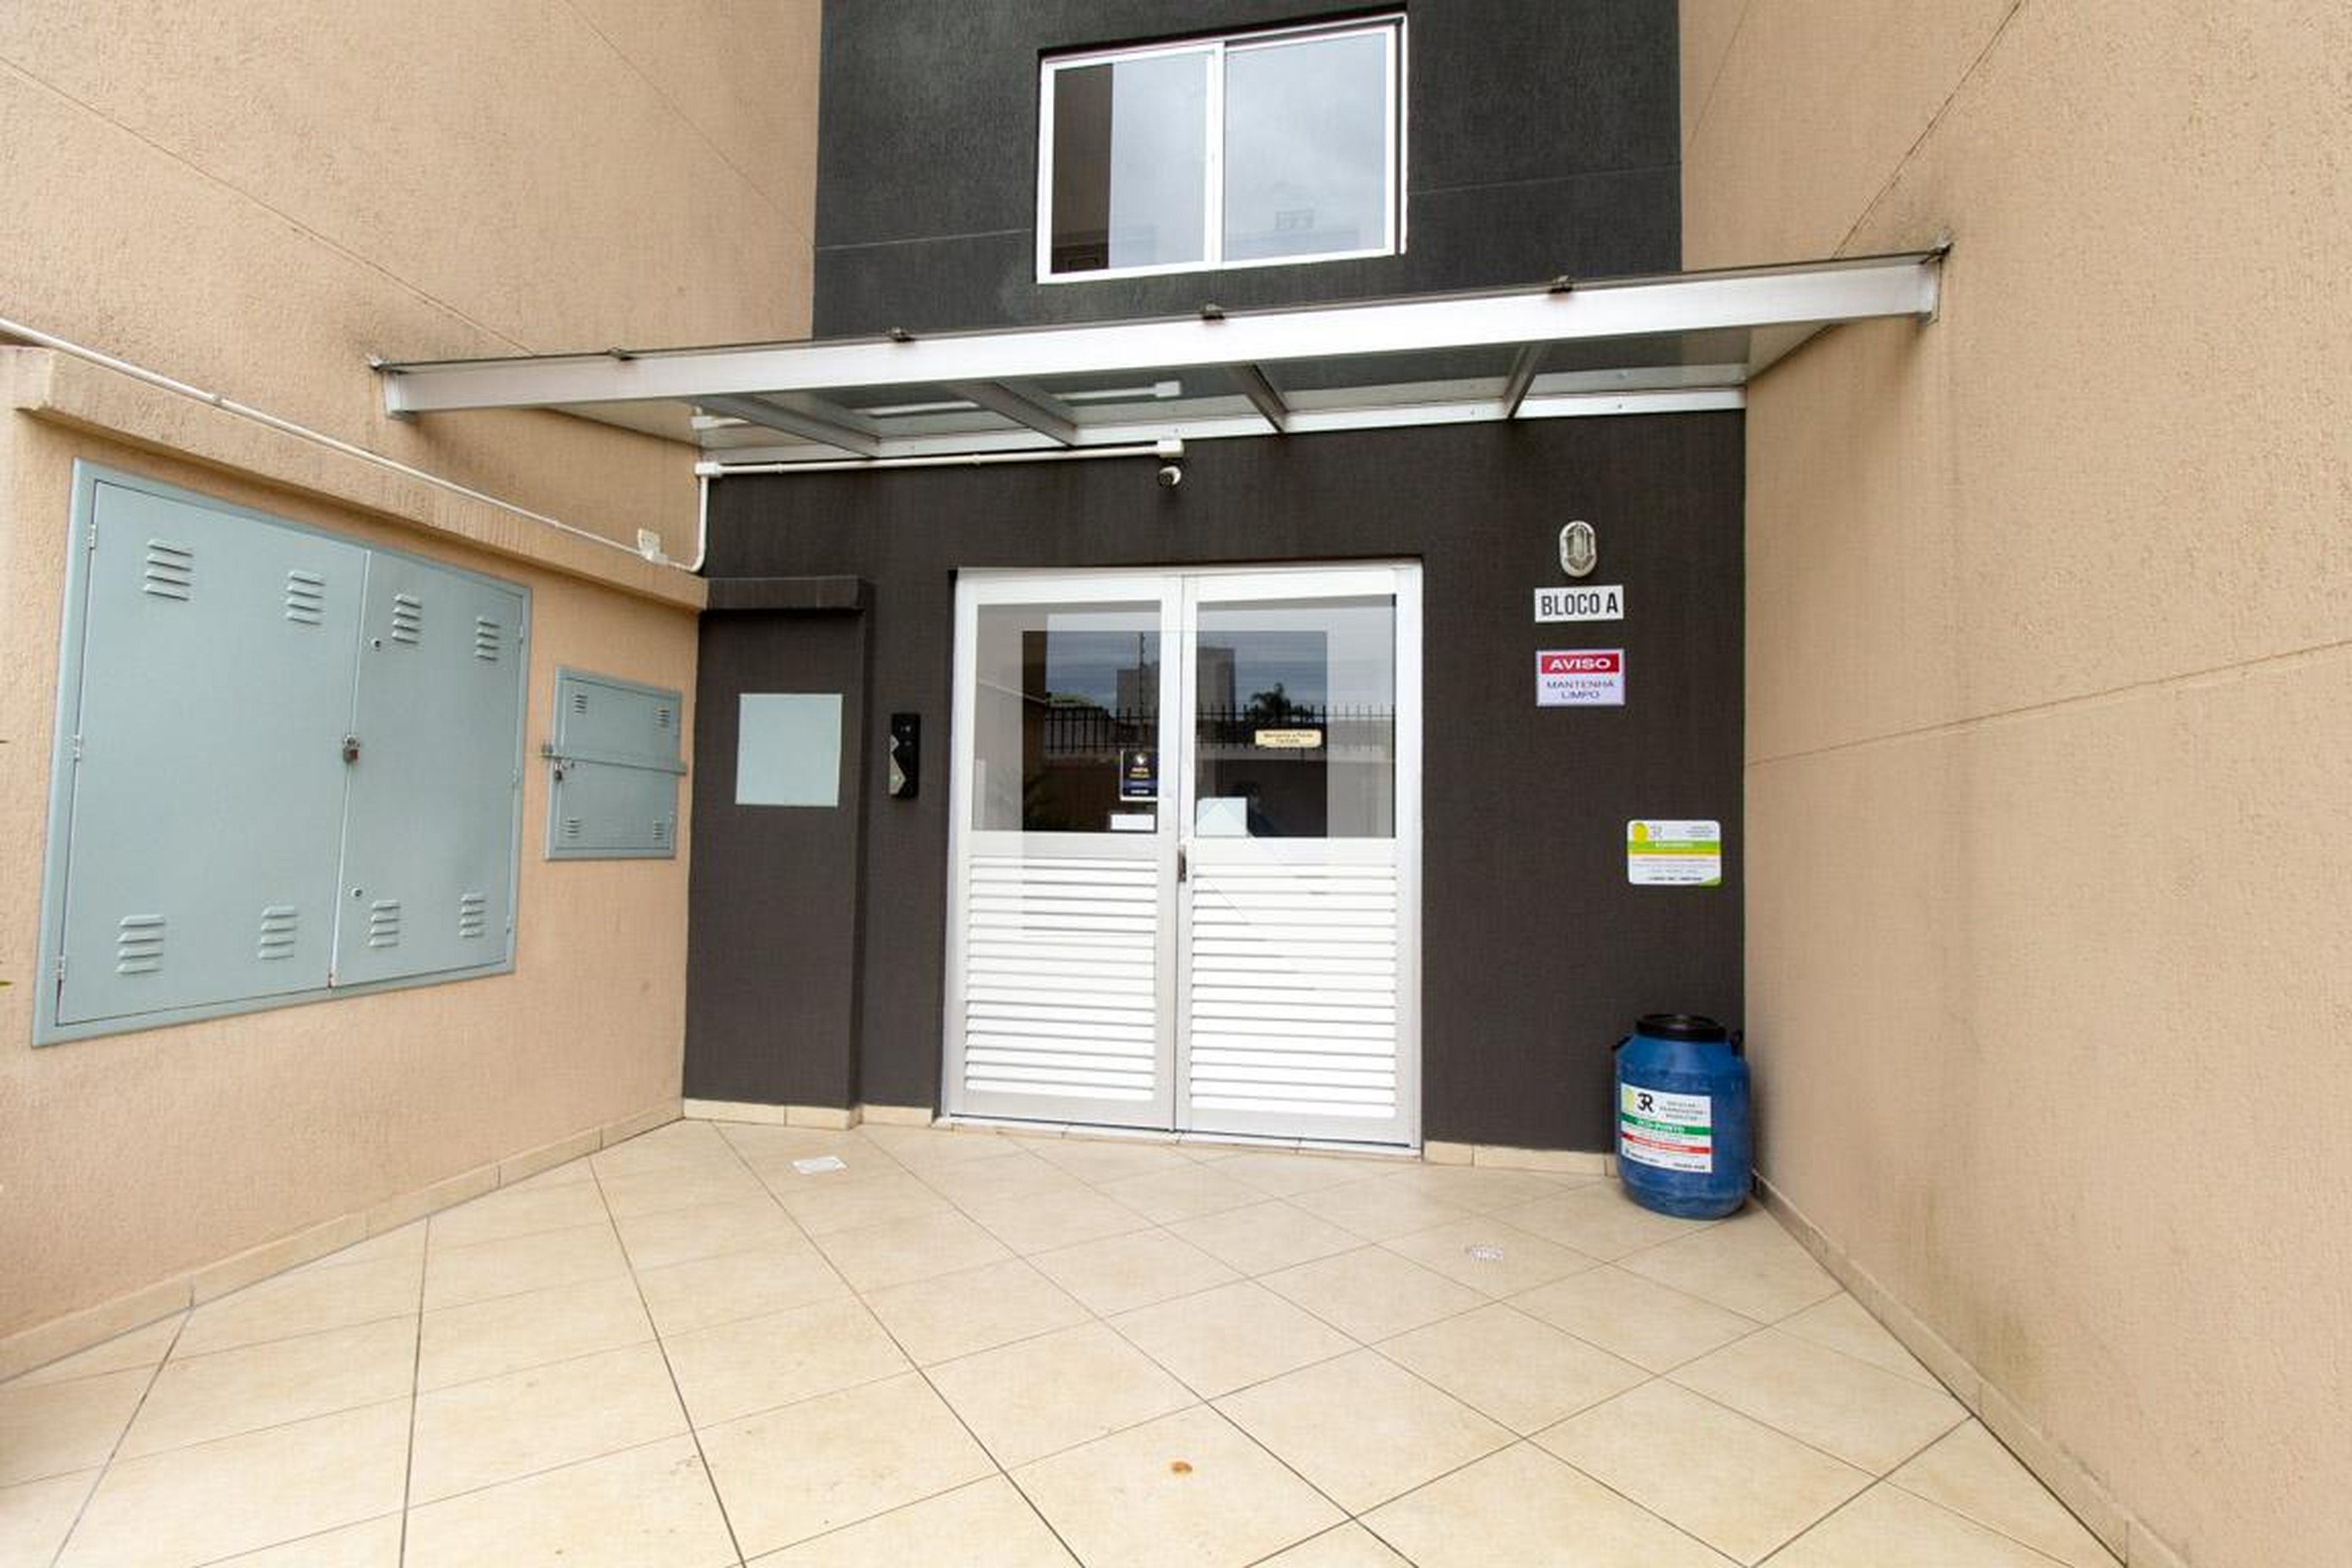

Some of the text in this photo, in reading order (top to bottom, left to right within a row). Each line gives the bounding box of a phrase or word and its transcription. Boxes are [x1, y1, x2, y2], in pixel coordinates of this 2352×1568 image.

[1542, 592, 1619, 616] BLOCO A
[1549, 658, 1611, 670] AVISO
[1547, 680, 1614, 688] MANTENHA
[1561, 690, 1600, 699] LIMPO
